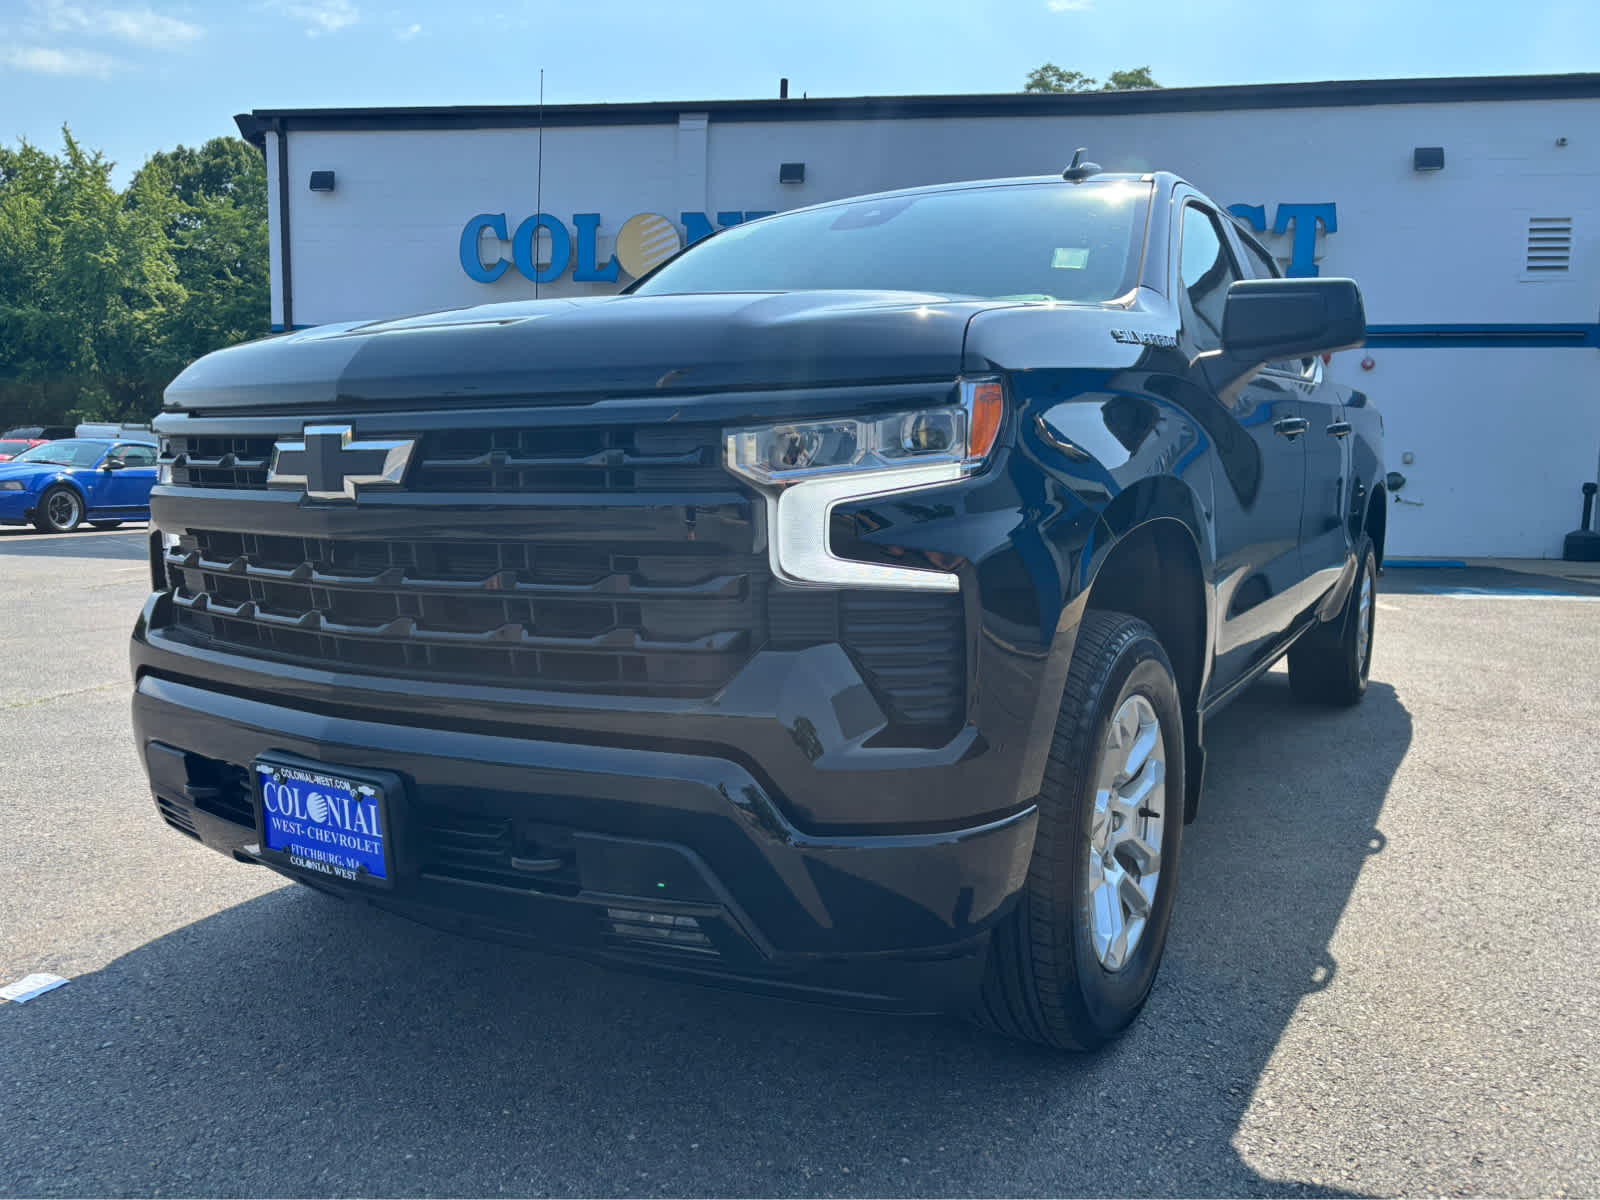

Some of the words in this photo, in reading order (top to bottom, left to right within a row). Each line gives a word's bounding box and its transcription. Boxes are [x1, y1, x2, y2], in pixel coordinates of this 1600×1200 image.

[263, 782, 383, 838] COLONIAL
[307, 826, 381, 855] CHEVROLET
[290, 856, 333, 874] COLONIAL
[333, 866, 357, 881] WEST
